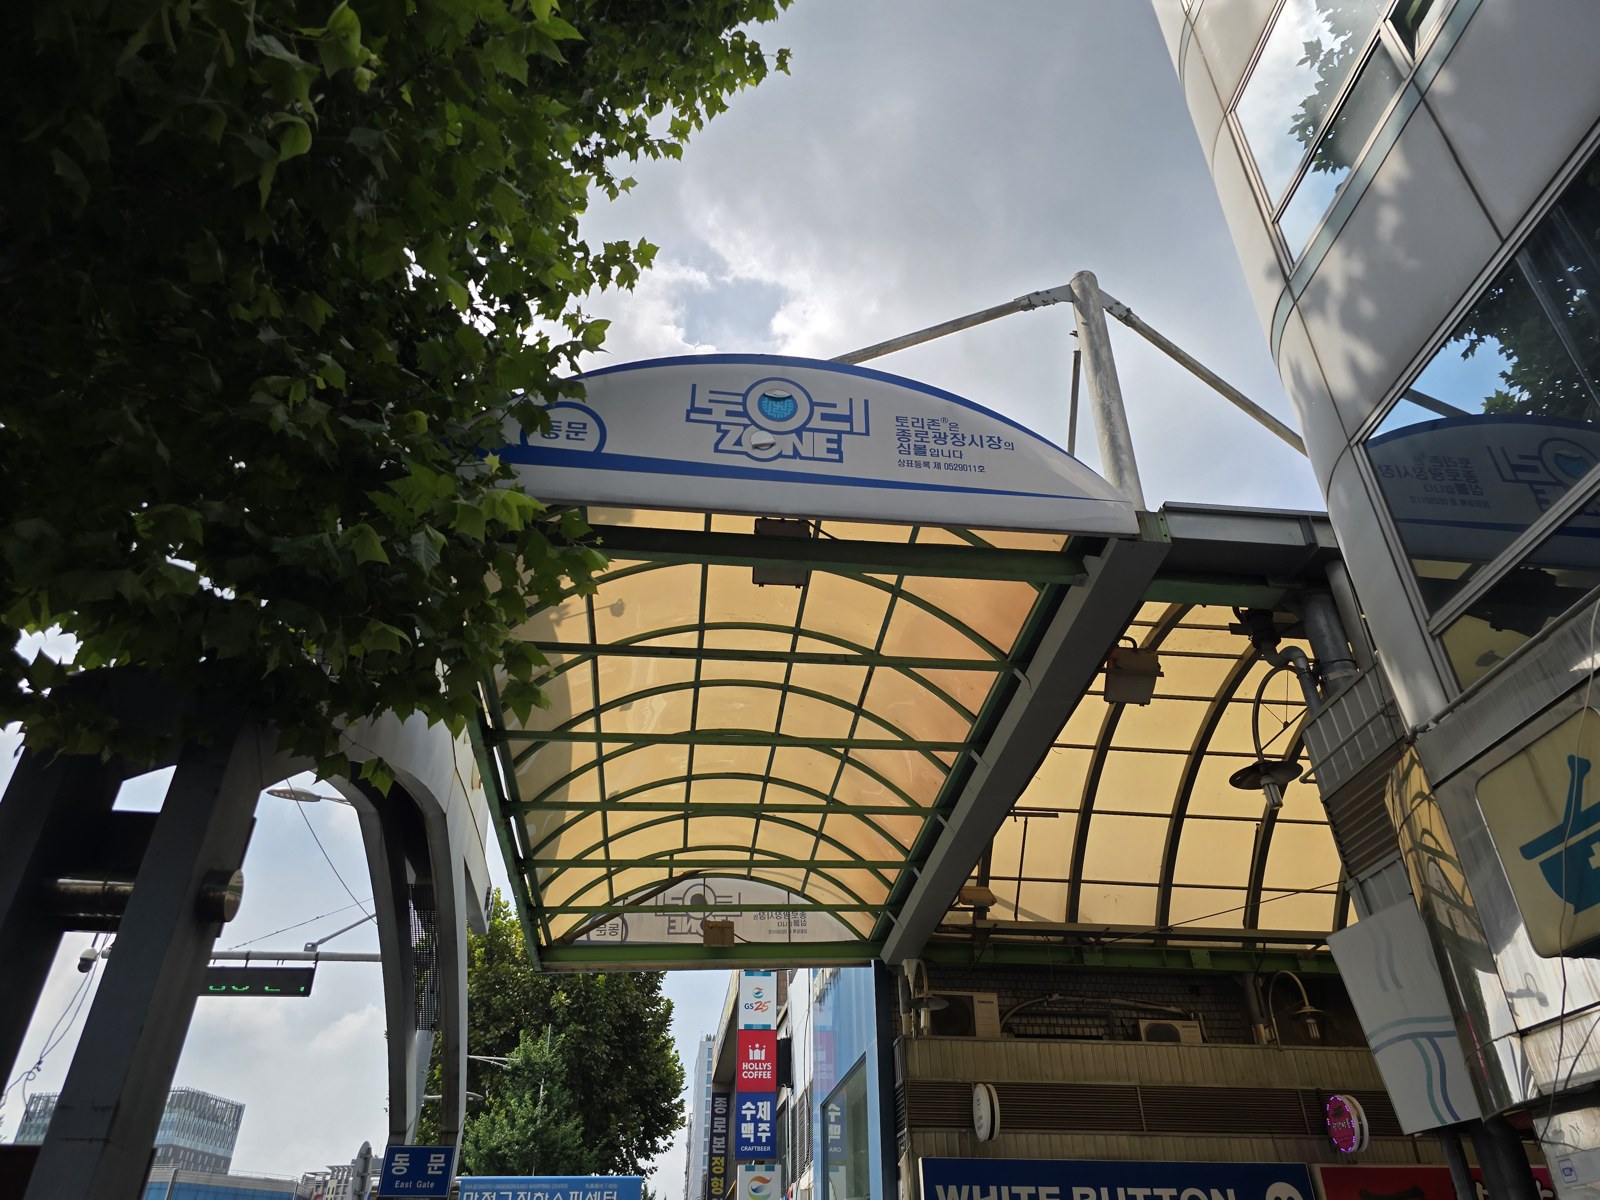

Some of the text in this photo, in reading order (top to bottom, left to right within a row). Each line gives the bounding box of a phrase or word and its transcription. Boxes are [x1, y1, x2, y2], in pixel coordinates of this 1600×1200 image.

[714, 424, 844, 463] ZONE
[895, 428, 1015, 451] 종로광장시장의
[896, 442, 964, 459] 심볼입니다
[897, 459, 986, 473] 상표등록 제 0529011호
[744, 1001, 771, 1012] GS25
[742, 1062, 772, 1071] HOLLYS
[742, 1070, 772, 1079] COFFEE
[741, 1101, 771, 1121] 수제
[741, 1122, 771, 1143] 맥주
[394, 1180, 435, 1189] East Gate
